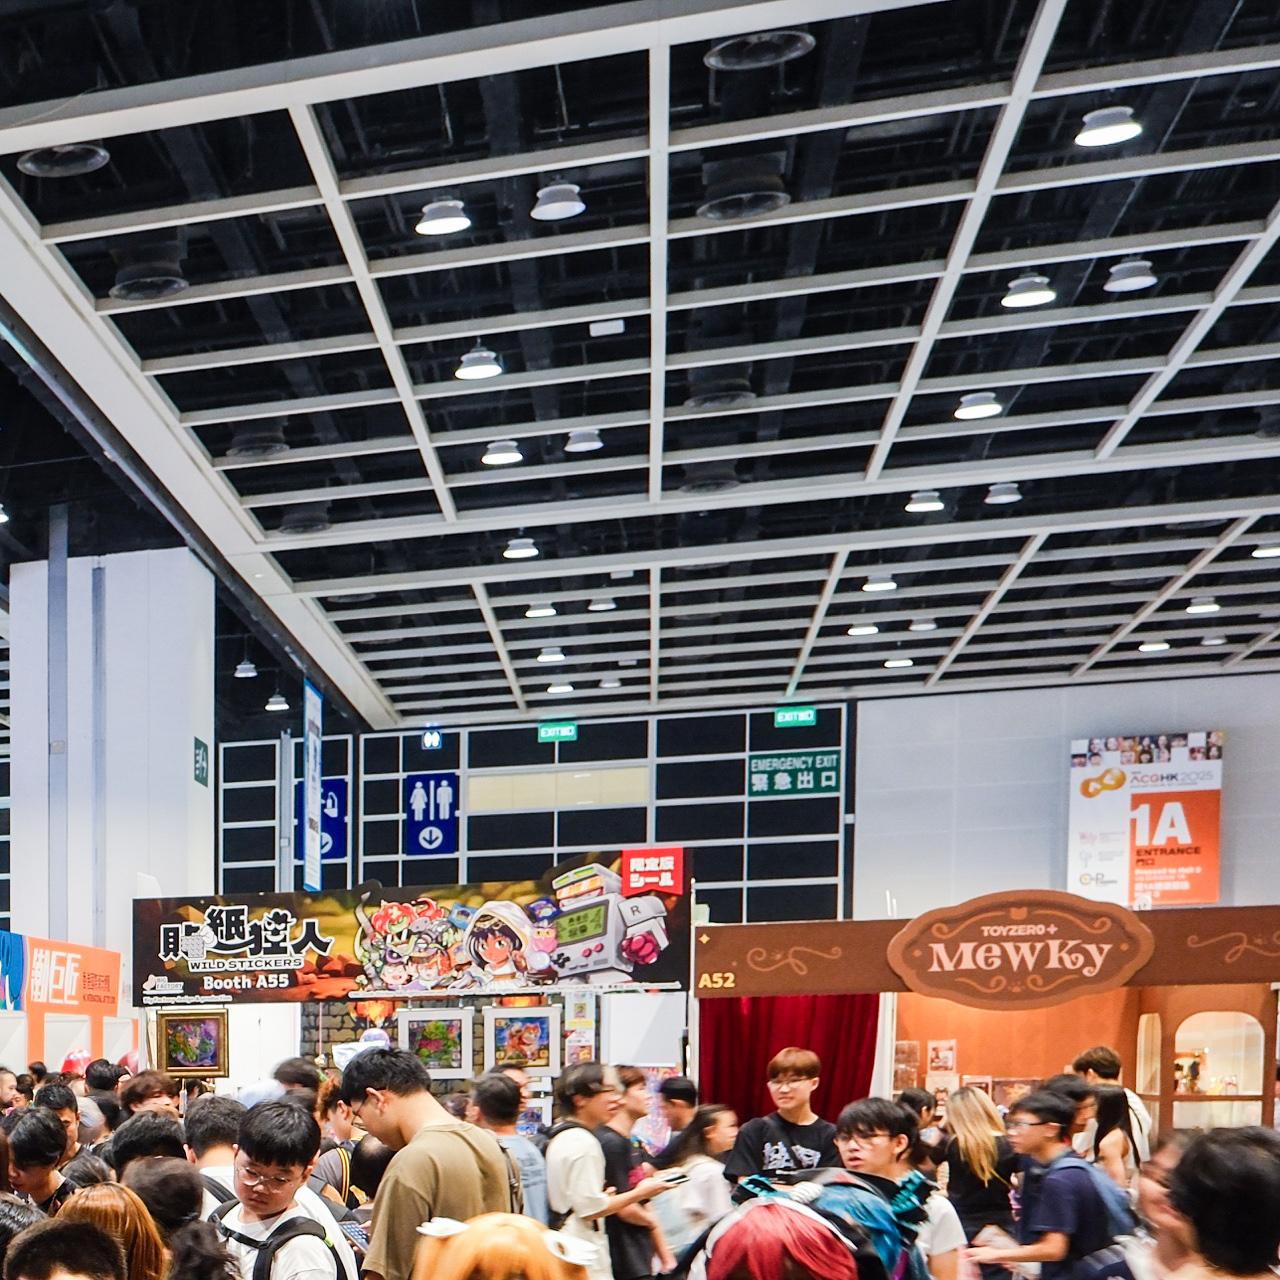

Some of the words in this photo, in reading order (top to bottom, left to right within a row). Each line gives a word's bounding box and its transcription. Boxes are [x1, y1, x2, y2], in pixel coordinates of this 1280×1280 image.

[751, 756, 814, 772] EMERGENCY
[816, 754, 838, 769] EXIT
[751, 771, 836, 792] 緊急出口
[1130, 801, 1192, 846] 1A
[1136, 847, 1201, 857] ENTRANCE
[630, 905, 642, 916] R
[190, 960, 225, 970] WILD
[230, 958, 303, 969] STICKERS
[203, 975, 251, 990] Booth
[256, 974, 289, 989] A55
[698, 972, 736, 989] A52
